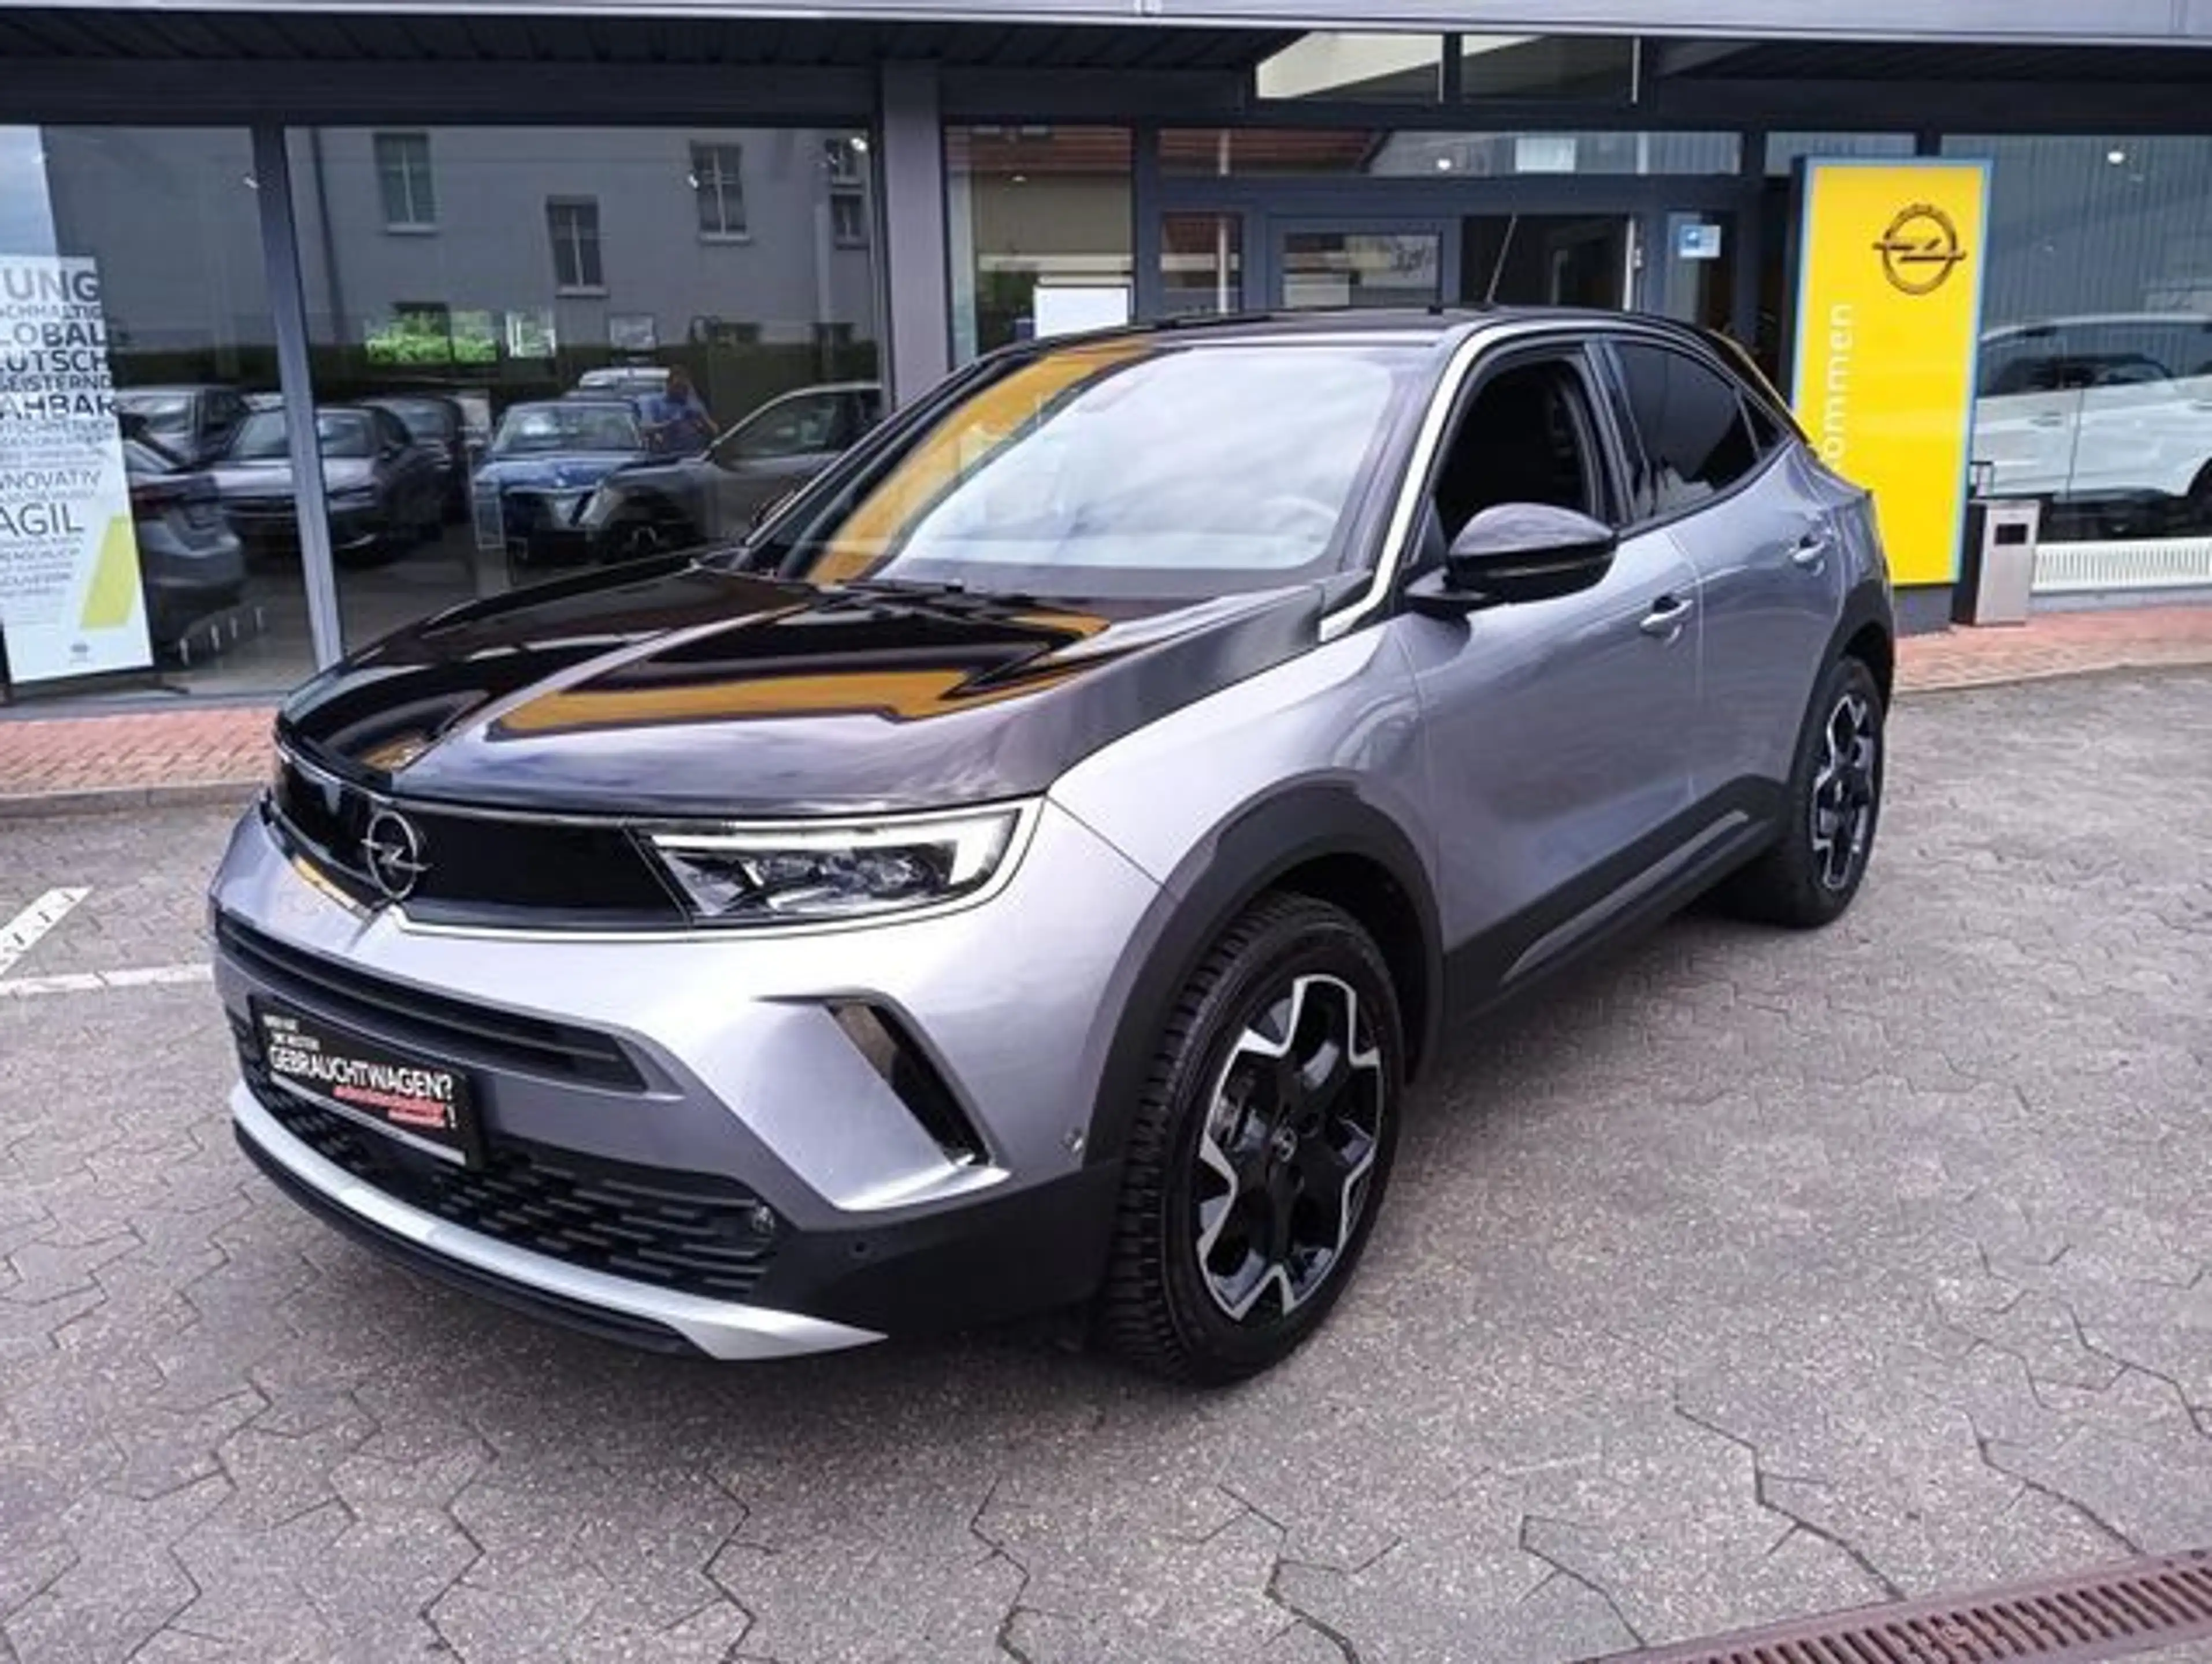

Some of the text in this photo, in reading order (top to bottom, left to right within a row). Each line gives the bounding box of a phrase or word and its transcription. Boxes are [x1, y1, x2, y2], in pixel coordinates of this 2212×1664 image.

[3, 268, 101, 303] UNG
[1821, 303, 1854, 470] ommen
[0, 469, 101, 491] NOVATIV
[269, 1045, 453, 1101] GEBRAUCHTWAGEN?
